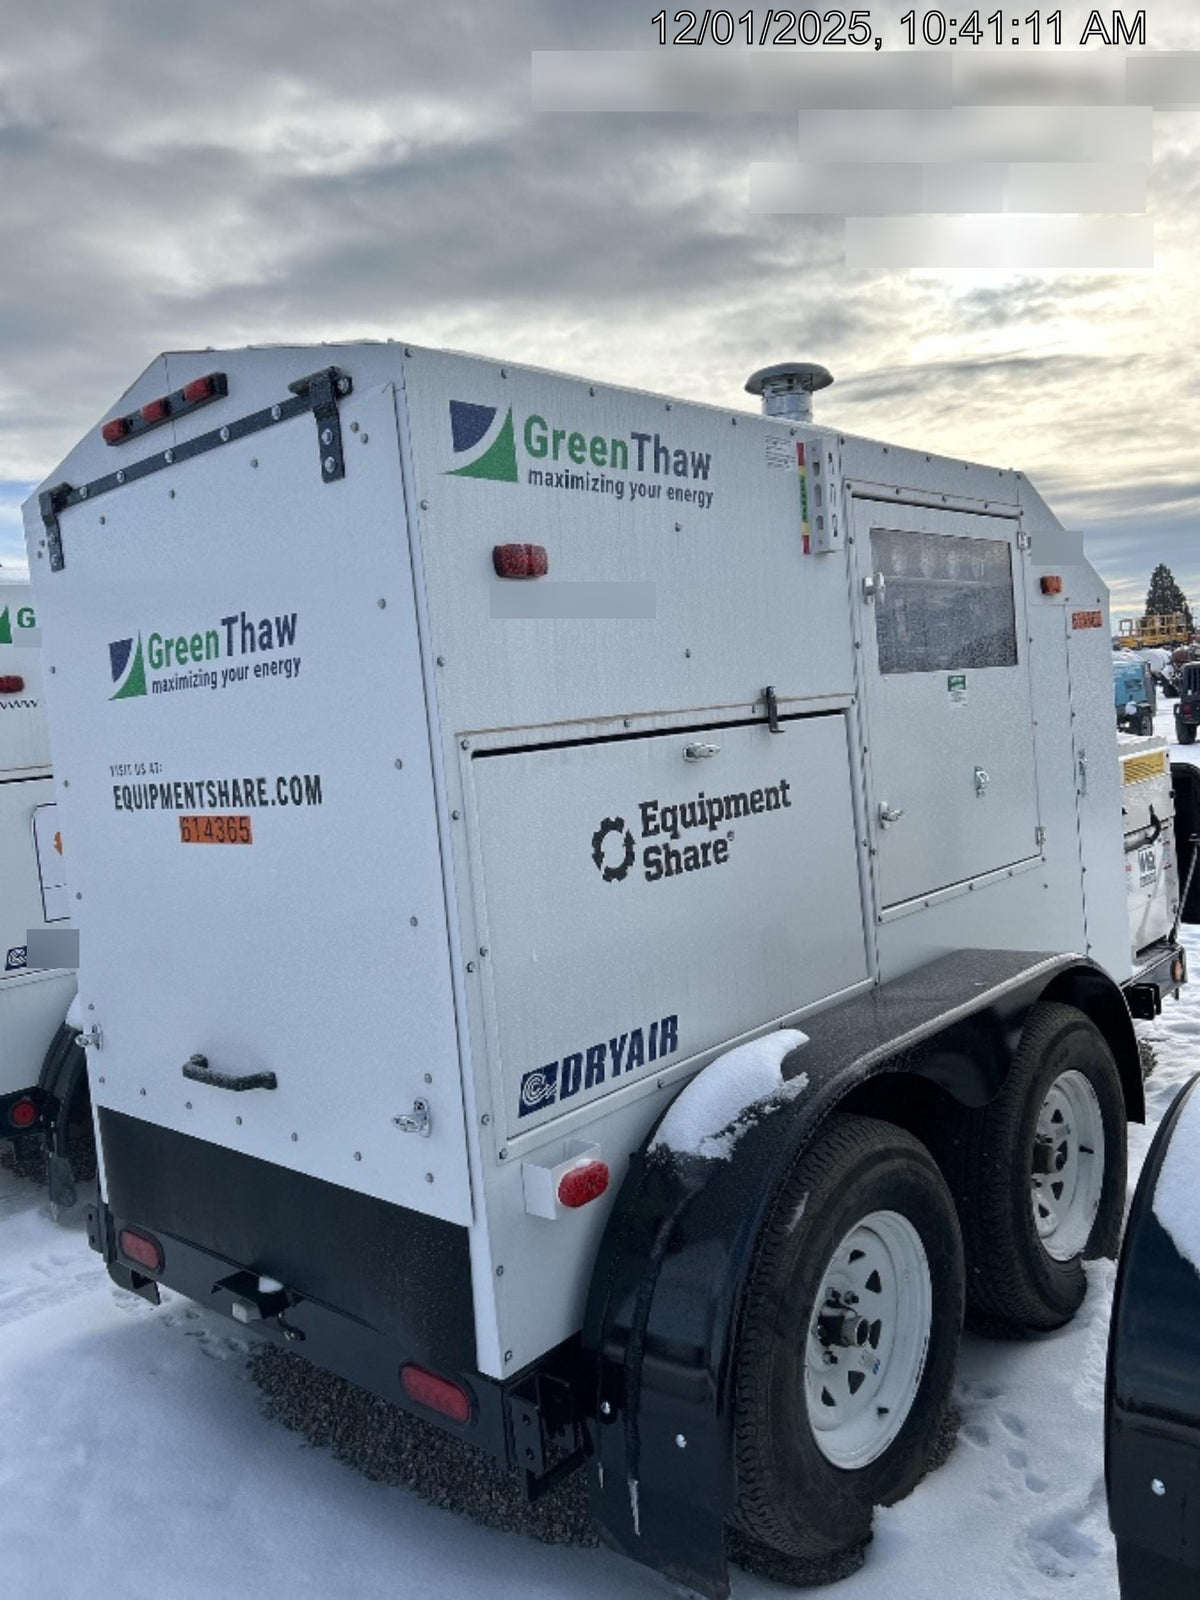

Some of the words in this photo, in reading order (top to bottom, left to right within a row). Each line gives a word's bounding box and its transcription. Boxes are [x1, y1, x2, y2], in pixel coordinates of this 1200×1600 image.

[523, 414, 712, 480] GreenThaw
[528, 468, 625, 500] maximizing
[629, 480, 662, 501] your
[666, 486, 714, 509] energy
[148, 611, 298, 670] GreenThaw
[152, 669, 218, 694] maximizing
[221, 665, 250, 688] your
[254, 656, 301, 678] energy
[134, 762, 146, 776] US
[112, 774, 323, 812] EQUIPMENTSHARE.COM
[638, 778, 792, 840] Equipment
[180, 816, 250, 844] 614365
[560, 1014, 679, 1101] DRYAIR
